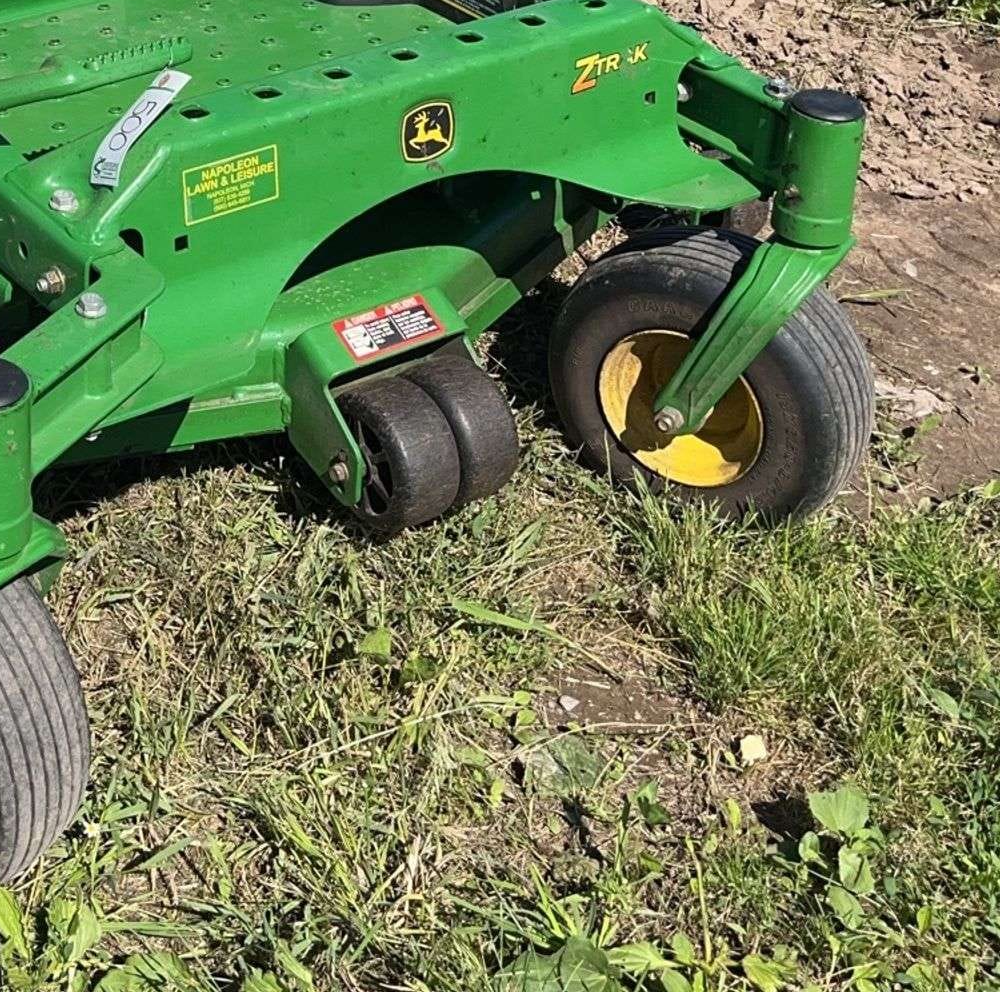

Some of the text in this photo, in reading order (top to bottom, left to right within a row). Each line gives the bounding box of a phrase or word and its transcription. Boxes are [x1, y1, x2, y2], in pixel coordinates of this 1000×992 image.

[186, 176, 220, 197] LAWN
[220, 174, 231, 187] &
[230, 161, 276, 184] LEISURE
[200, 155, 260, 180] NAPOLEON
